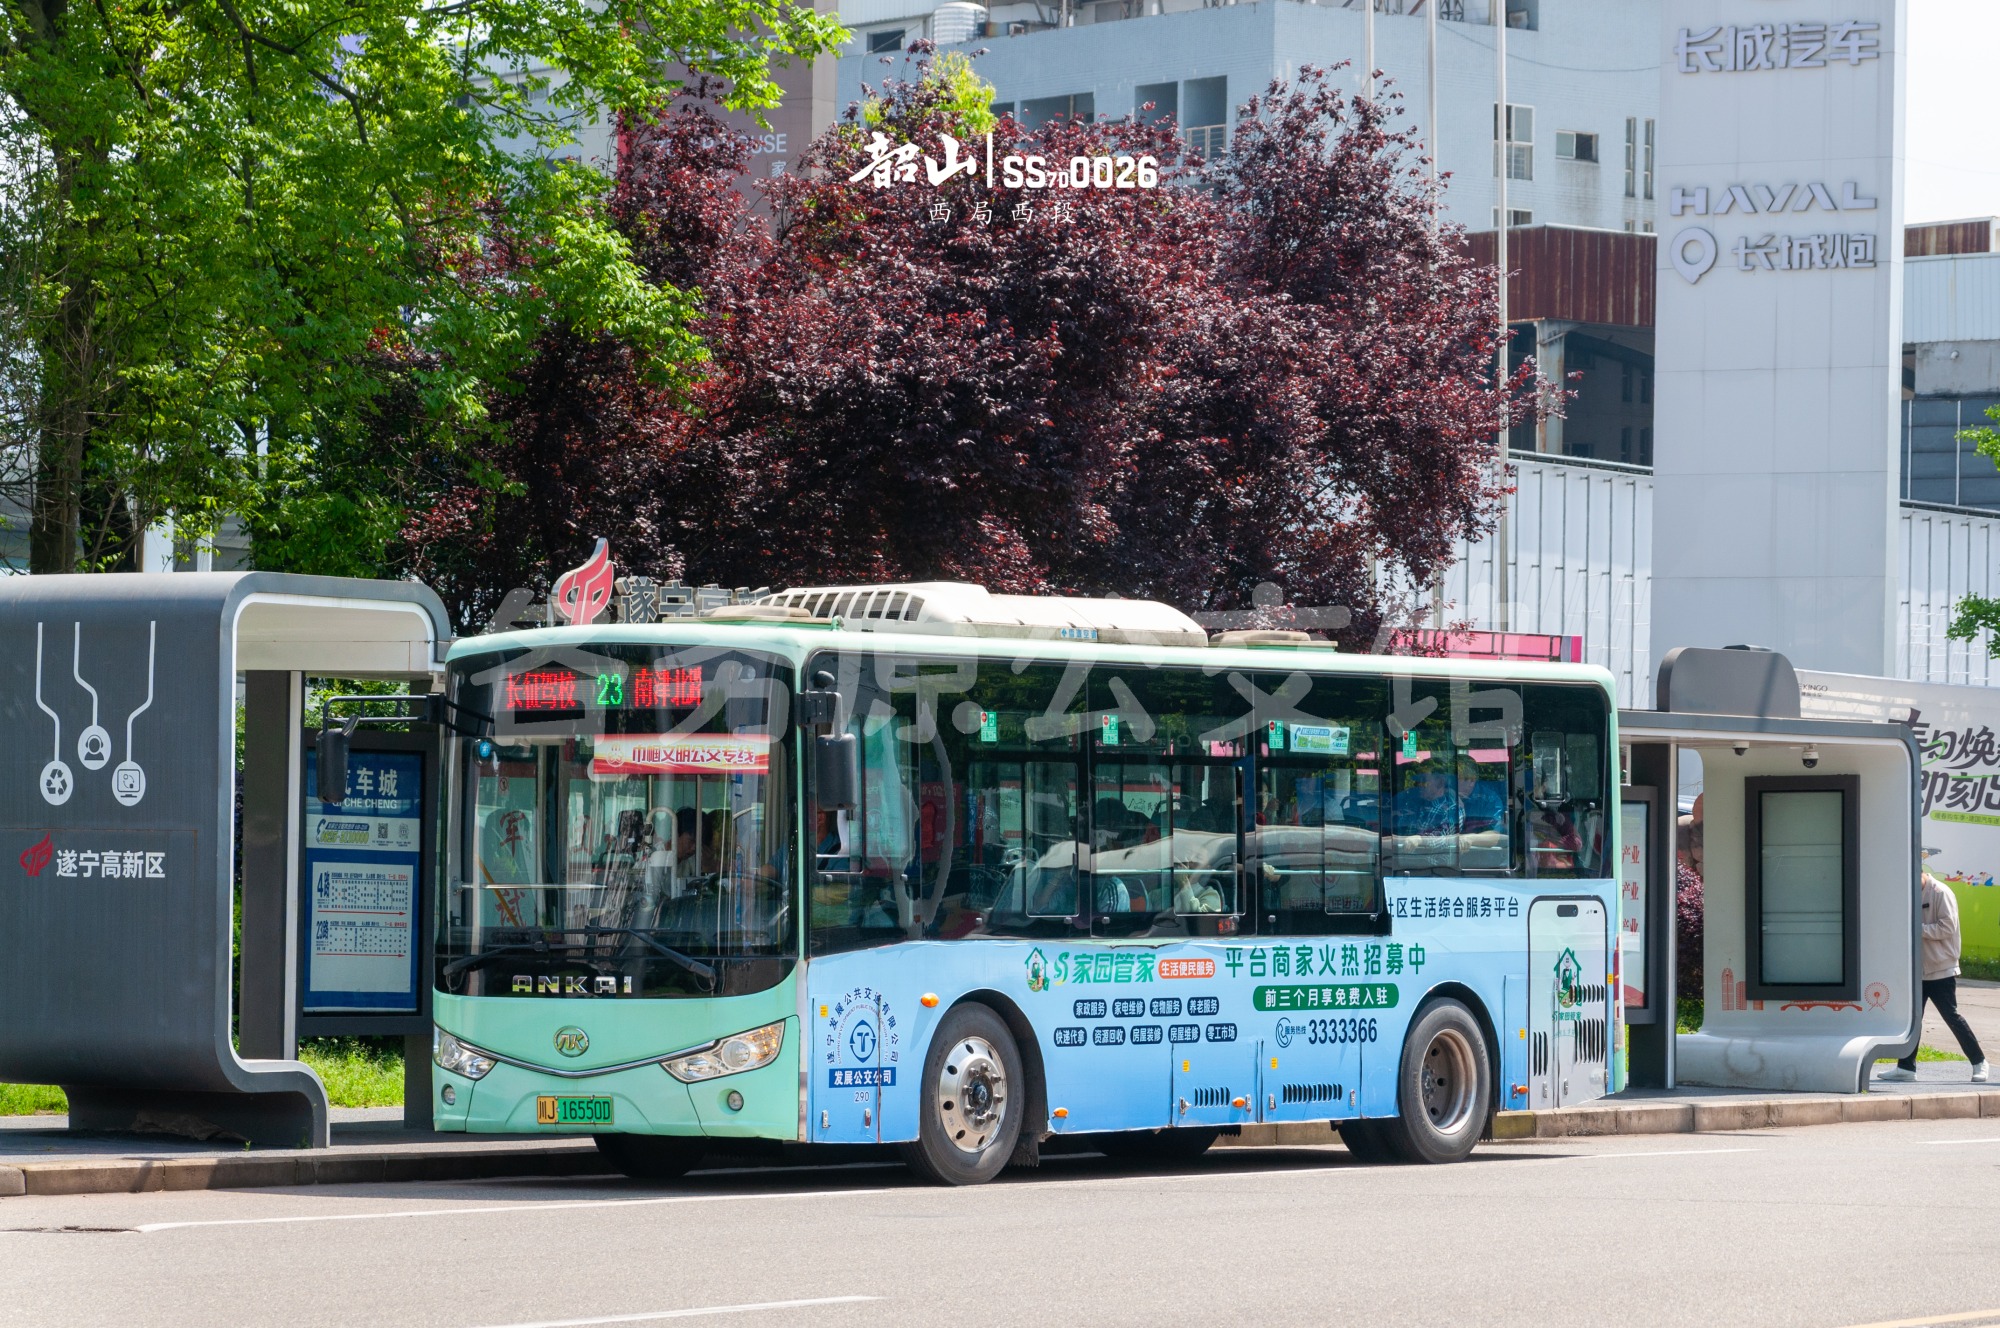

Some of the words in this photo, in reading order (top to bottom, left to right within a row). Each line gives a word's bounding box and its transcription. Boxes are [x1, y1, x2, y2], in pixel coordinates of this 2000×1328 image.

[1673, 20, 1880, 73] 长城汽车
[1670, 182, 1878, 216] HAVAL
[1732, 233, 1877, 271] 长城炮
[596, 673, 624, 705] 23
[631, 744, 756, 765] 巾帼文明公交专线
[345, 767, 398, 797] 车城
[344, 797, 363, 808] CHE
[365, 798, 398, 809] CHENG
[56, 849, 166, 880] 遂宁高新区
[1072, 952, 1156, 984] 家园管家
[1161, 961, 1215, 977] 生活便民服务
[1225, 943, 1425, 978] 平台商家火热招募中
[512, 975, 633, 994] ANKAI
[1265, 986, 1388, 1008] 前三个月享免费入驻
[1075, 1001, 1105, 1017] 家政服务
[1114, 1000, 1144, 1015] 家电维修
[1151, 1000, 1181, 1015] 宠物服务
[1189, 999, 1218, 1014] 养老服务
[1055, 1030, 1085, 1045] 快递代拿
[1094, 1028, 1124, 1044] 资源回收
[1132, 1027, 1162, 1043] 房屋装修
[1170, 1026, 1199, 1042] 房屋维修
[1207, 1025, 1236, 1041] 零工市场
[1308, 1017, 1378, 1045] 3333366
[834, 1069, 892, 1086] 发展公交公司
[854, 1091, 870, 1102] 290
